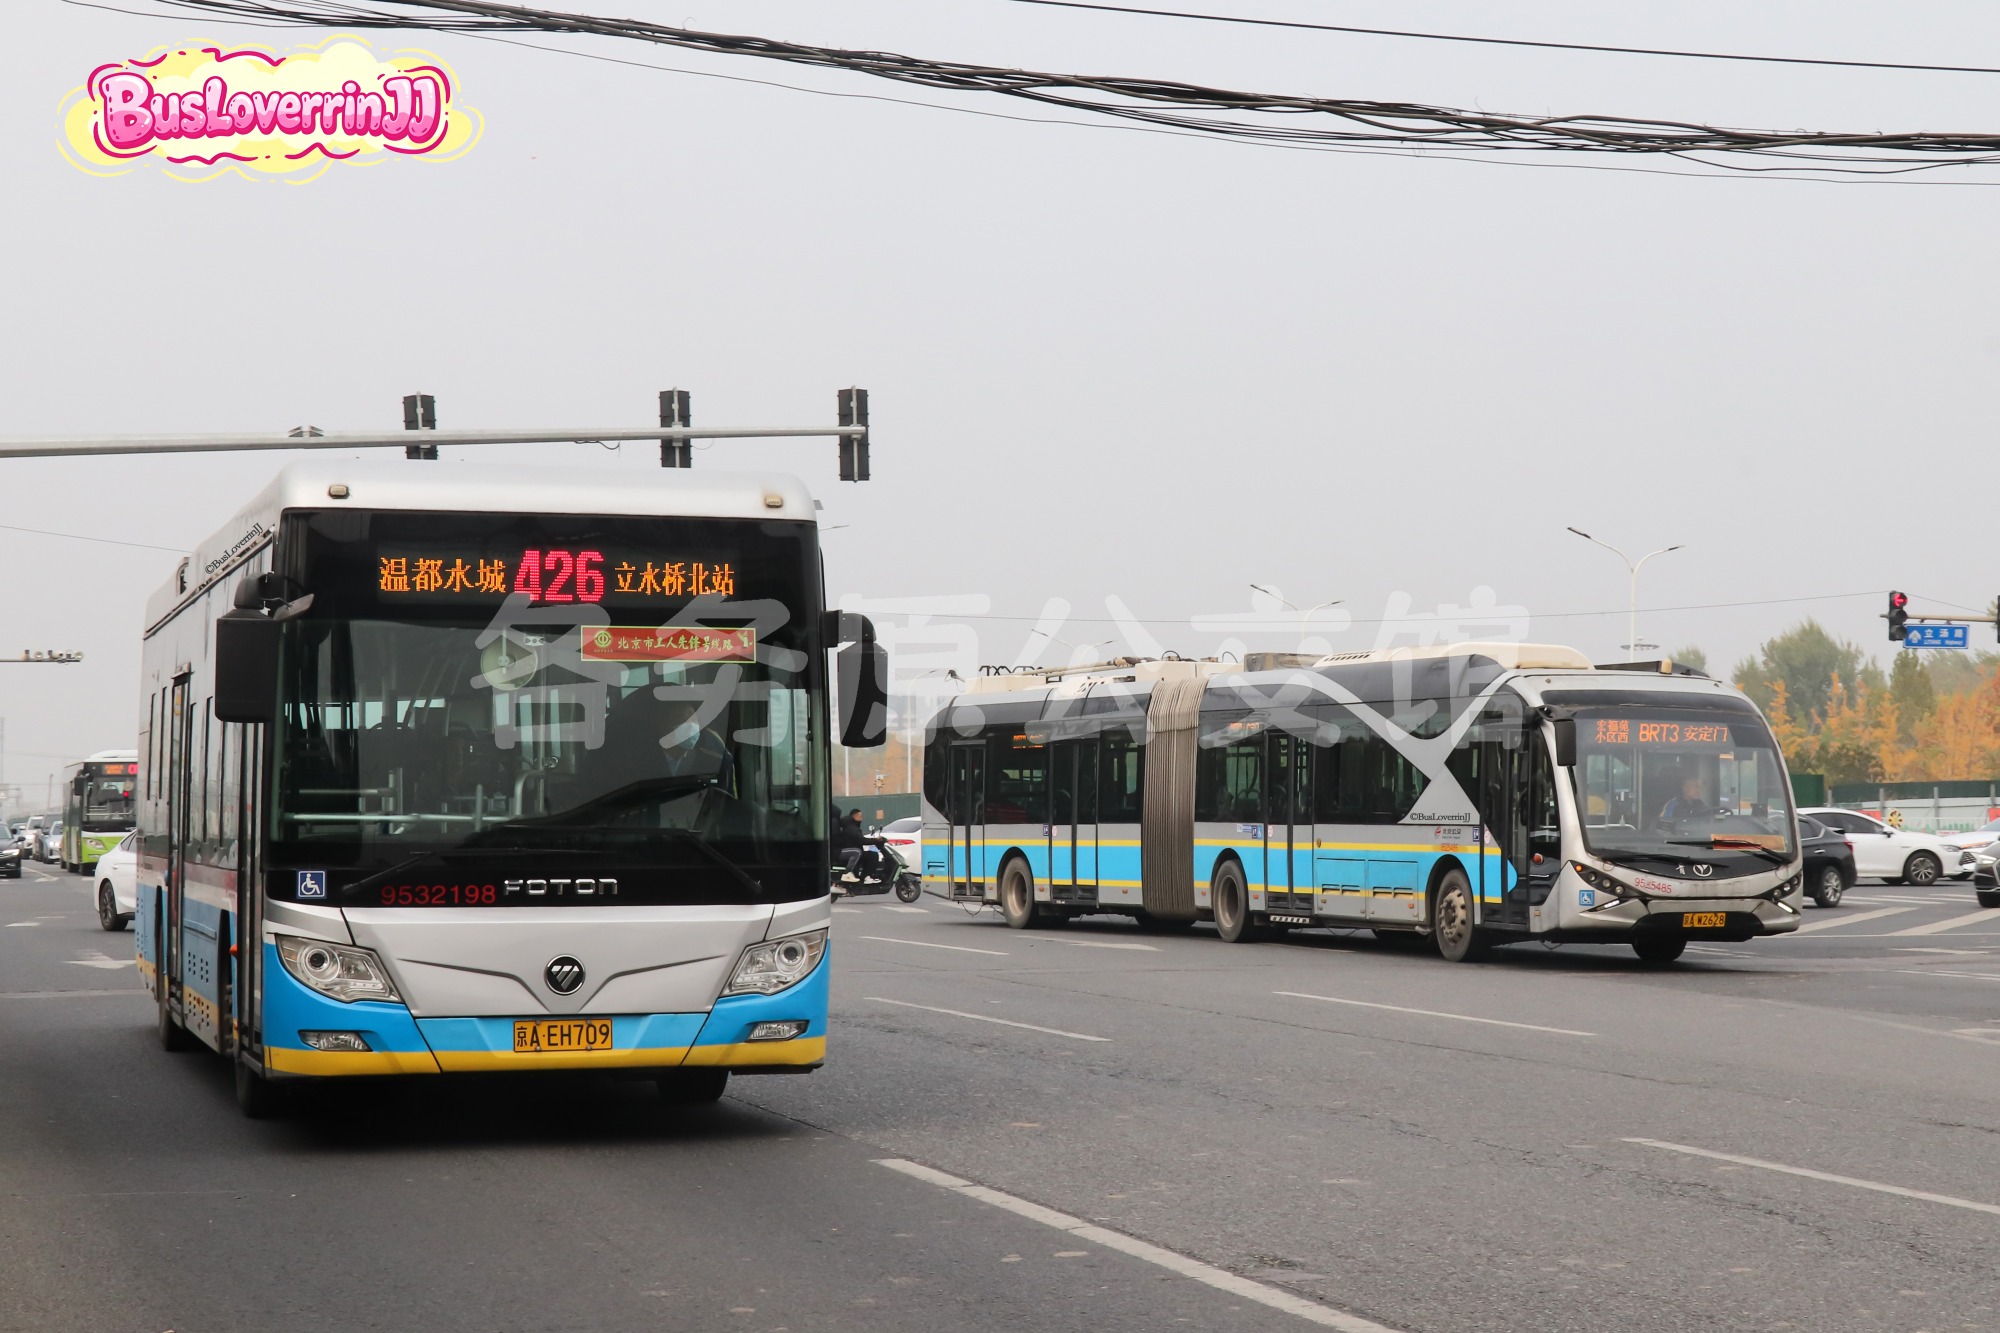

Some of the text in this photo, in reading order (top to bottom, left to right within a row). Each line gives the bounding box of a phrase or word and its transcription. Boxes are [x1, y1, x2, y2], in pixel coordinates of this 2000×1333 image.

[380, 550, 734, 601] 温都水城 426 立水桥北站
[1639, 723, 1728, 742] BRT3 安定门
[380, 878, 618, 905] 9532198 FOTON
